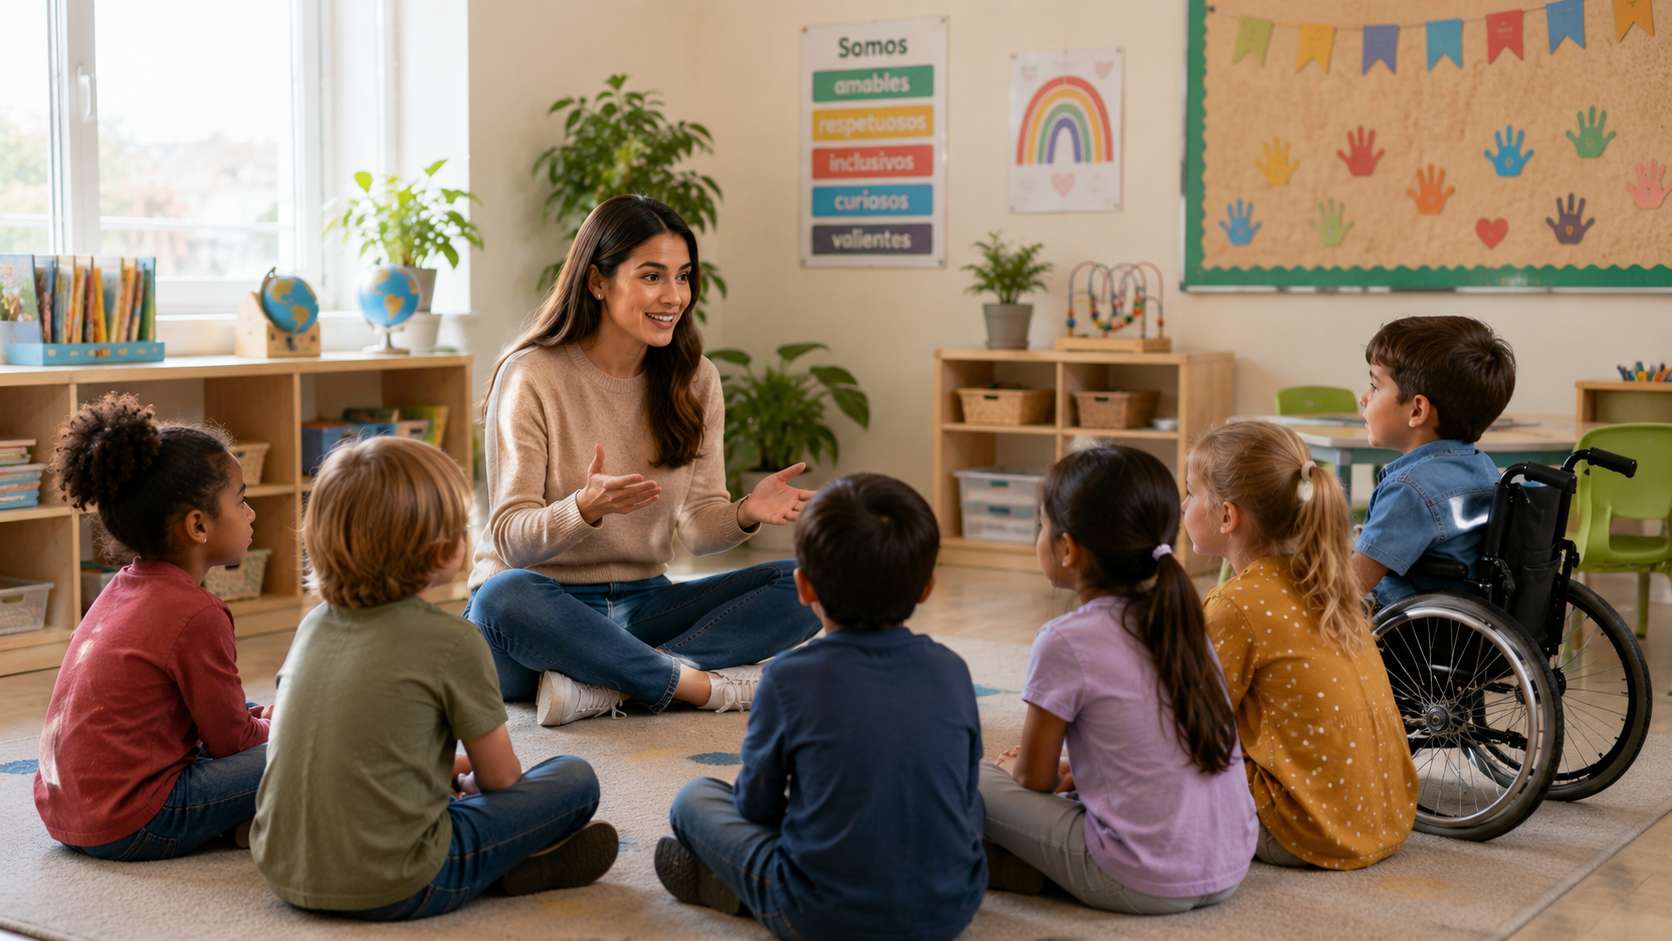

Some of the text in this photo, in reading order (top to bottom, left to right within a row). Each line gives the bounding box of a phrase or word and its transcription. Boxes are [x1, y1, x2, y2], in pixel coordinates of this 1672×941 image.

[838, 37, 908, 58] Somos
[834, 73, 911, 95] amables
[819, 112, 928, 137] respetuosos
[829, 152, 915, 172] inclusivos
[834, 190, 910, 211] curiosos
[832, 229, 912, 249] valientes
